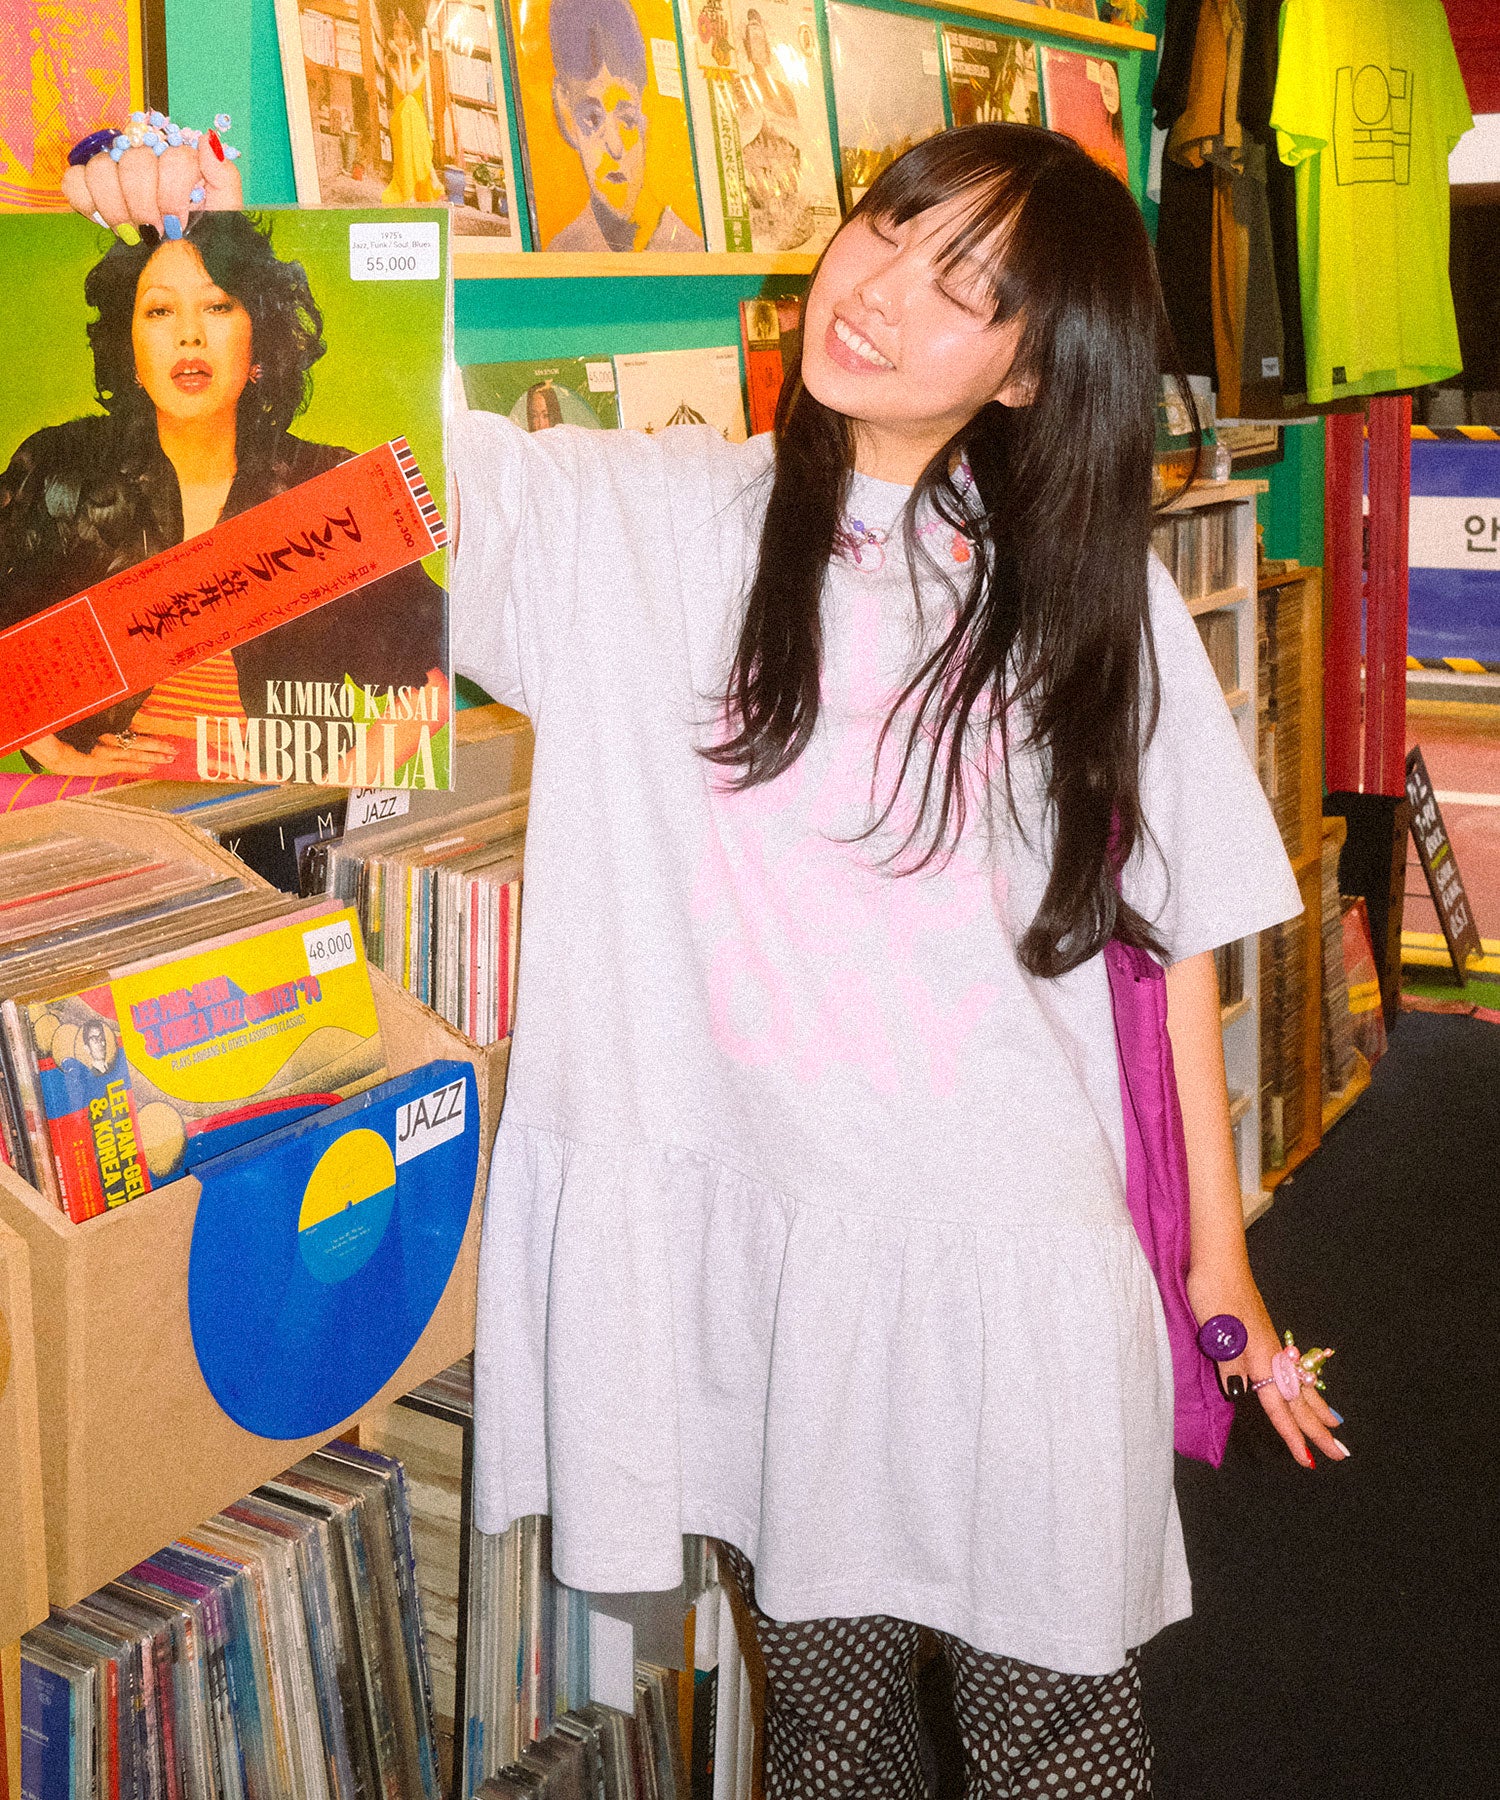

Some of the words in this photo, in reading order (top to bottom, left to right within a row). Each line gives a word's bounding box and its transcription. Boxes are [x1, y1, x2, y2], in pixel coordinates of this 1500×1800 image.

[366, 256, 416, 272] 55,000
[370, 241, 387, 249] Funk
[391, 508, 417, 549] ¥2,300
[266, 679, 355, 718] KIMIKO
[363, 684, 440, 722] KASAI
[193, 715, 440, 790] UMBRELLA
[362, 796, 397, 824] JAZZ
[309, 932, 352, 960] 48,000
[171, 1056, 192, 1072] PLAYS
[228, 1037, 248, 1052] OTHER
[280, 1013, 306, 1032] CLASSICS
[89, 1097, 109, 1120] &
[106, 1079, 130, 1118] LEE
[398, 1080, 463, 1142] JAZZ
[93, 1119, 122, 1188] KOREA
